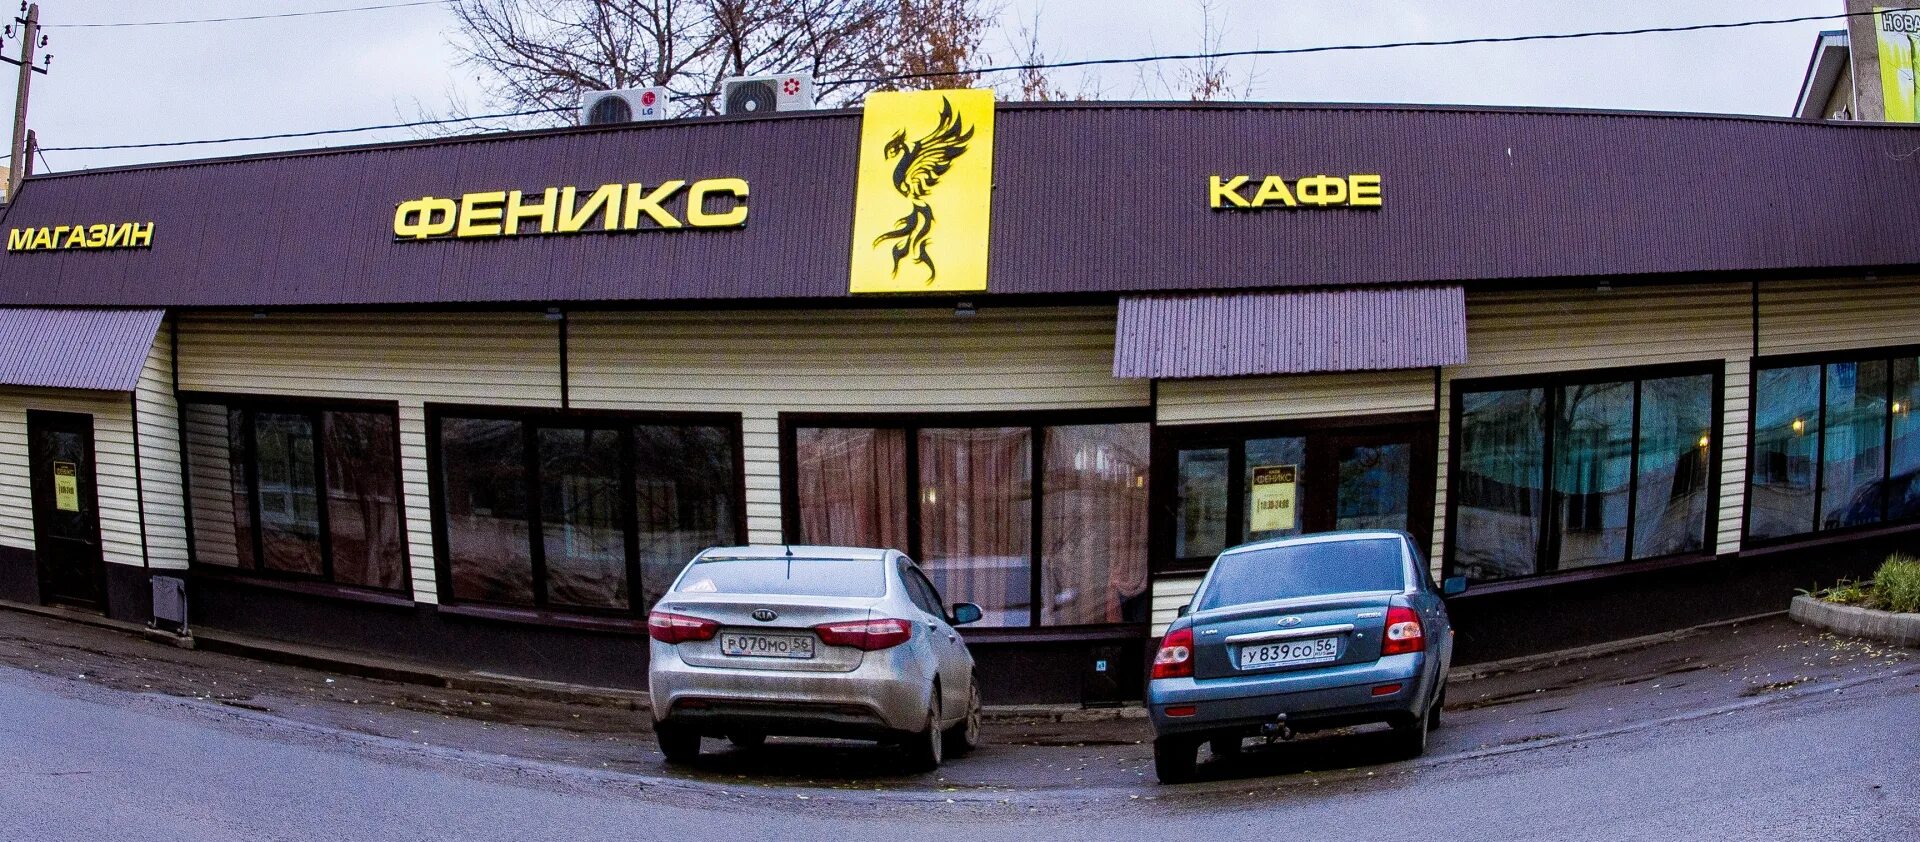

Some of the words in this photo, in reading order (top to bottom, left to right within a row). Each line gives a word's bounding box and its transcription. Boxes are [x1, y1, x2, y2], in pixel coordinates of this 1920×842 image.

[642, 107, 654, 115] LG
[1209, 174, 1382, 208] КАФЕ
[394, 177, 750, 240] ФЕНИКС
[7, 221, 154, 251] МАГАЗИН
[1256, 473, 1292, 484] ФЕНИКС
[754, 611, 774, 621] KIA
[793, 638, 809, 650] 56
[1315, 638, 1332, 652] 56
